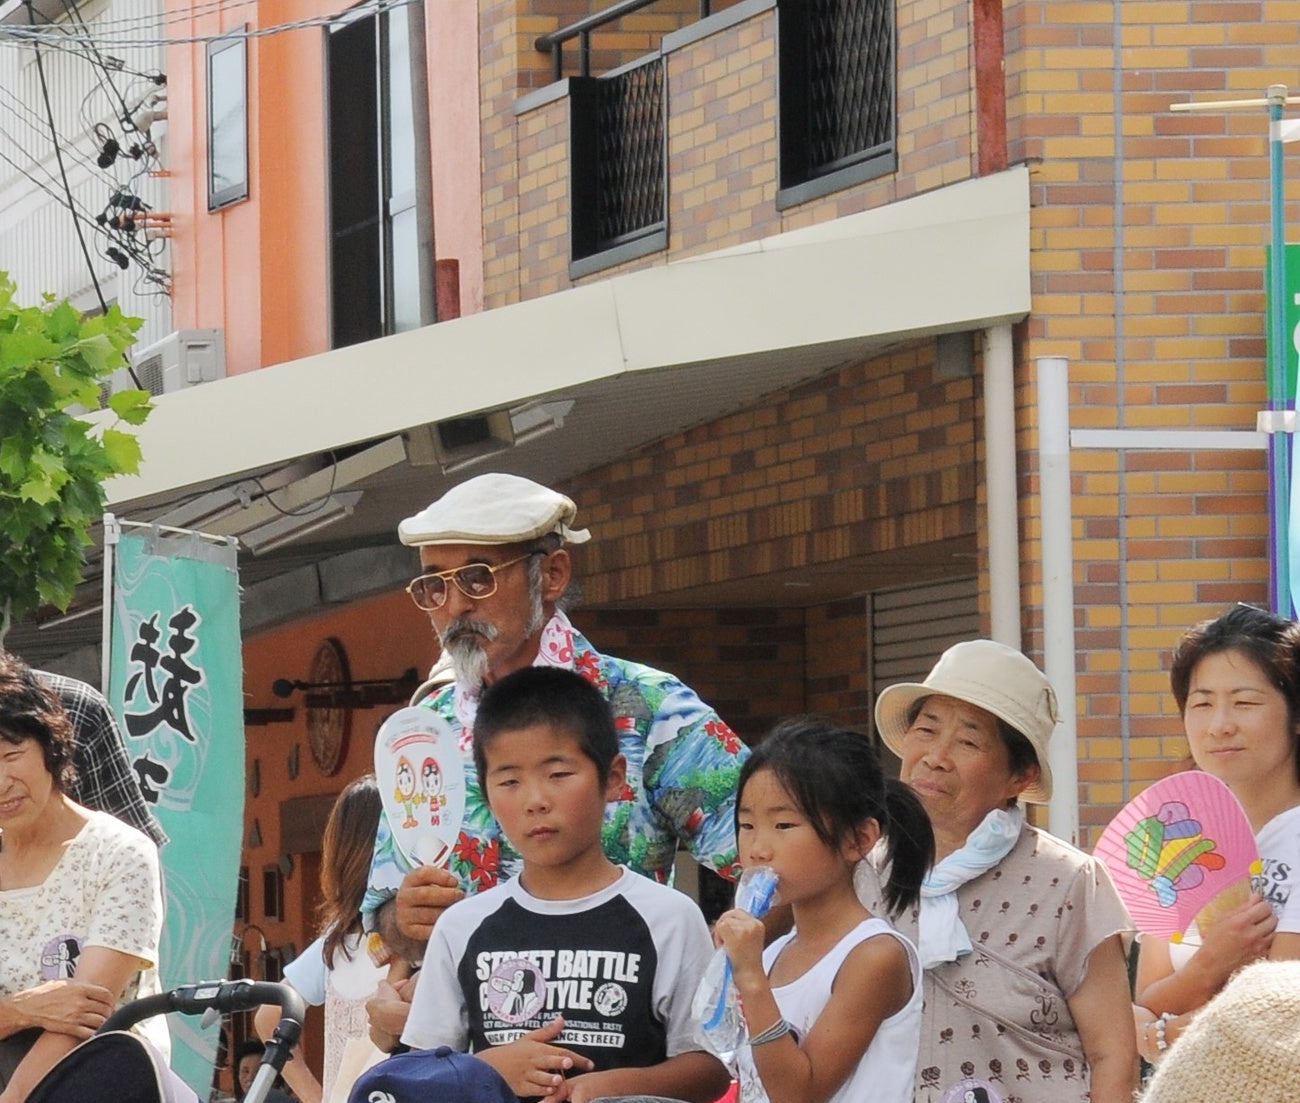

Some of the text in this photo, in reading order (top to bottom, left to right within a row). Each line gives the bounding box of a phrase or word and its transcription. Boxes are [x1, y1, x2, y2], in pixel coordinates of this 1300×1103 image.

[476, 949, 642, 983] STET BATTLE
[546, 979, 594, 1011] TYLE
[524, 1020, 541, 1029] FEEL
[488, 1033, 504, 1043] HIGH
[583, 1033, 621, 1046] STREET
